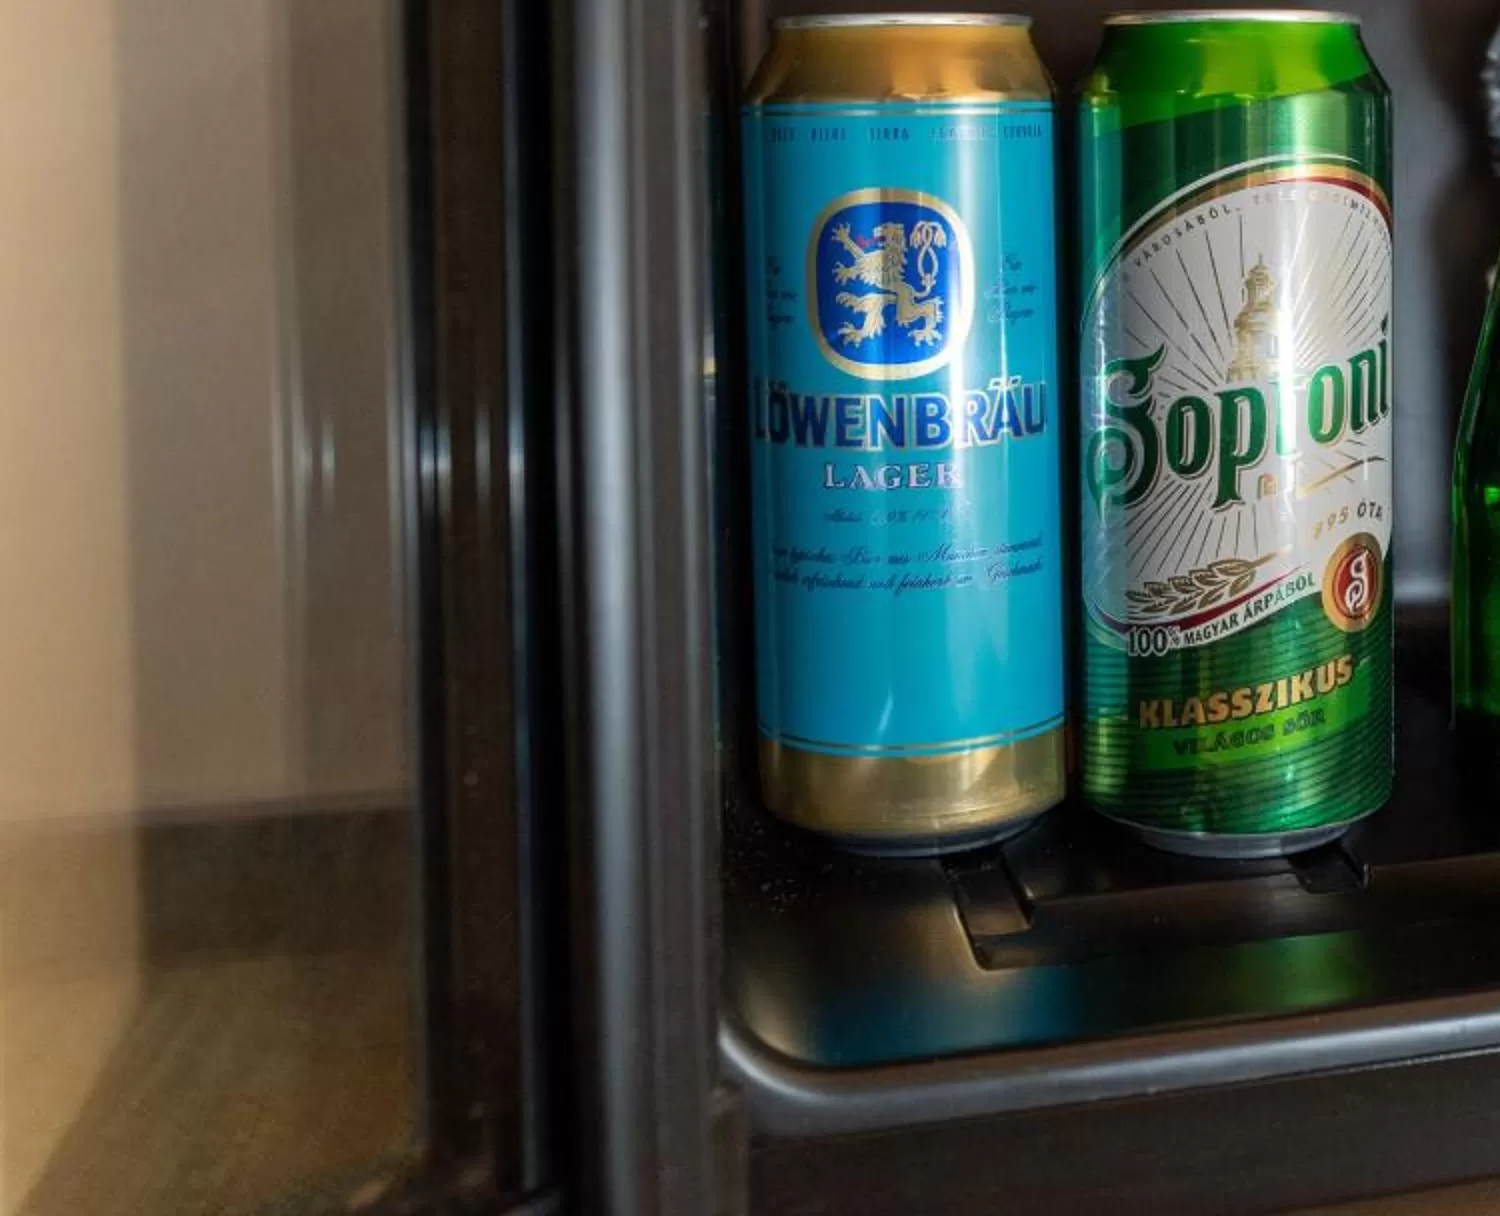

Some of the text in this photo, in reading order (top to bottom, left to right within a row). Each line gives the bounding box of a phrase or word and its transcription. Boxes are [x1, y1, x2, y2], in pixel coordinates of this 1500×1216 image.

[753, 374, 1049, 452] LÖWENBRÄU
[1087, 313, 1390, 511] Soproni
[823, 462, 965, 491] LAGER
[1127, 624, 1182, 657] 100%
[1183, 613, 1239, 644] MAGYAR
[1138, 655, 1354, 729] KLASSZIKUS
